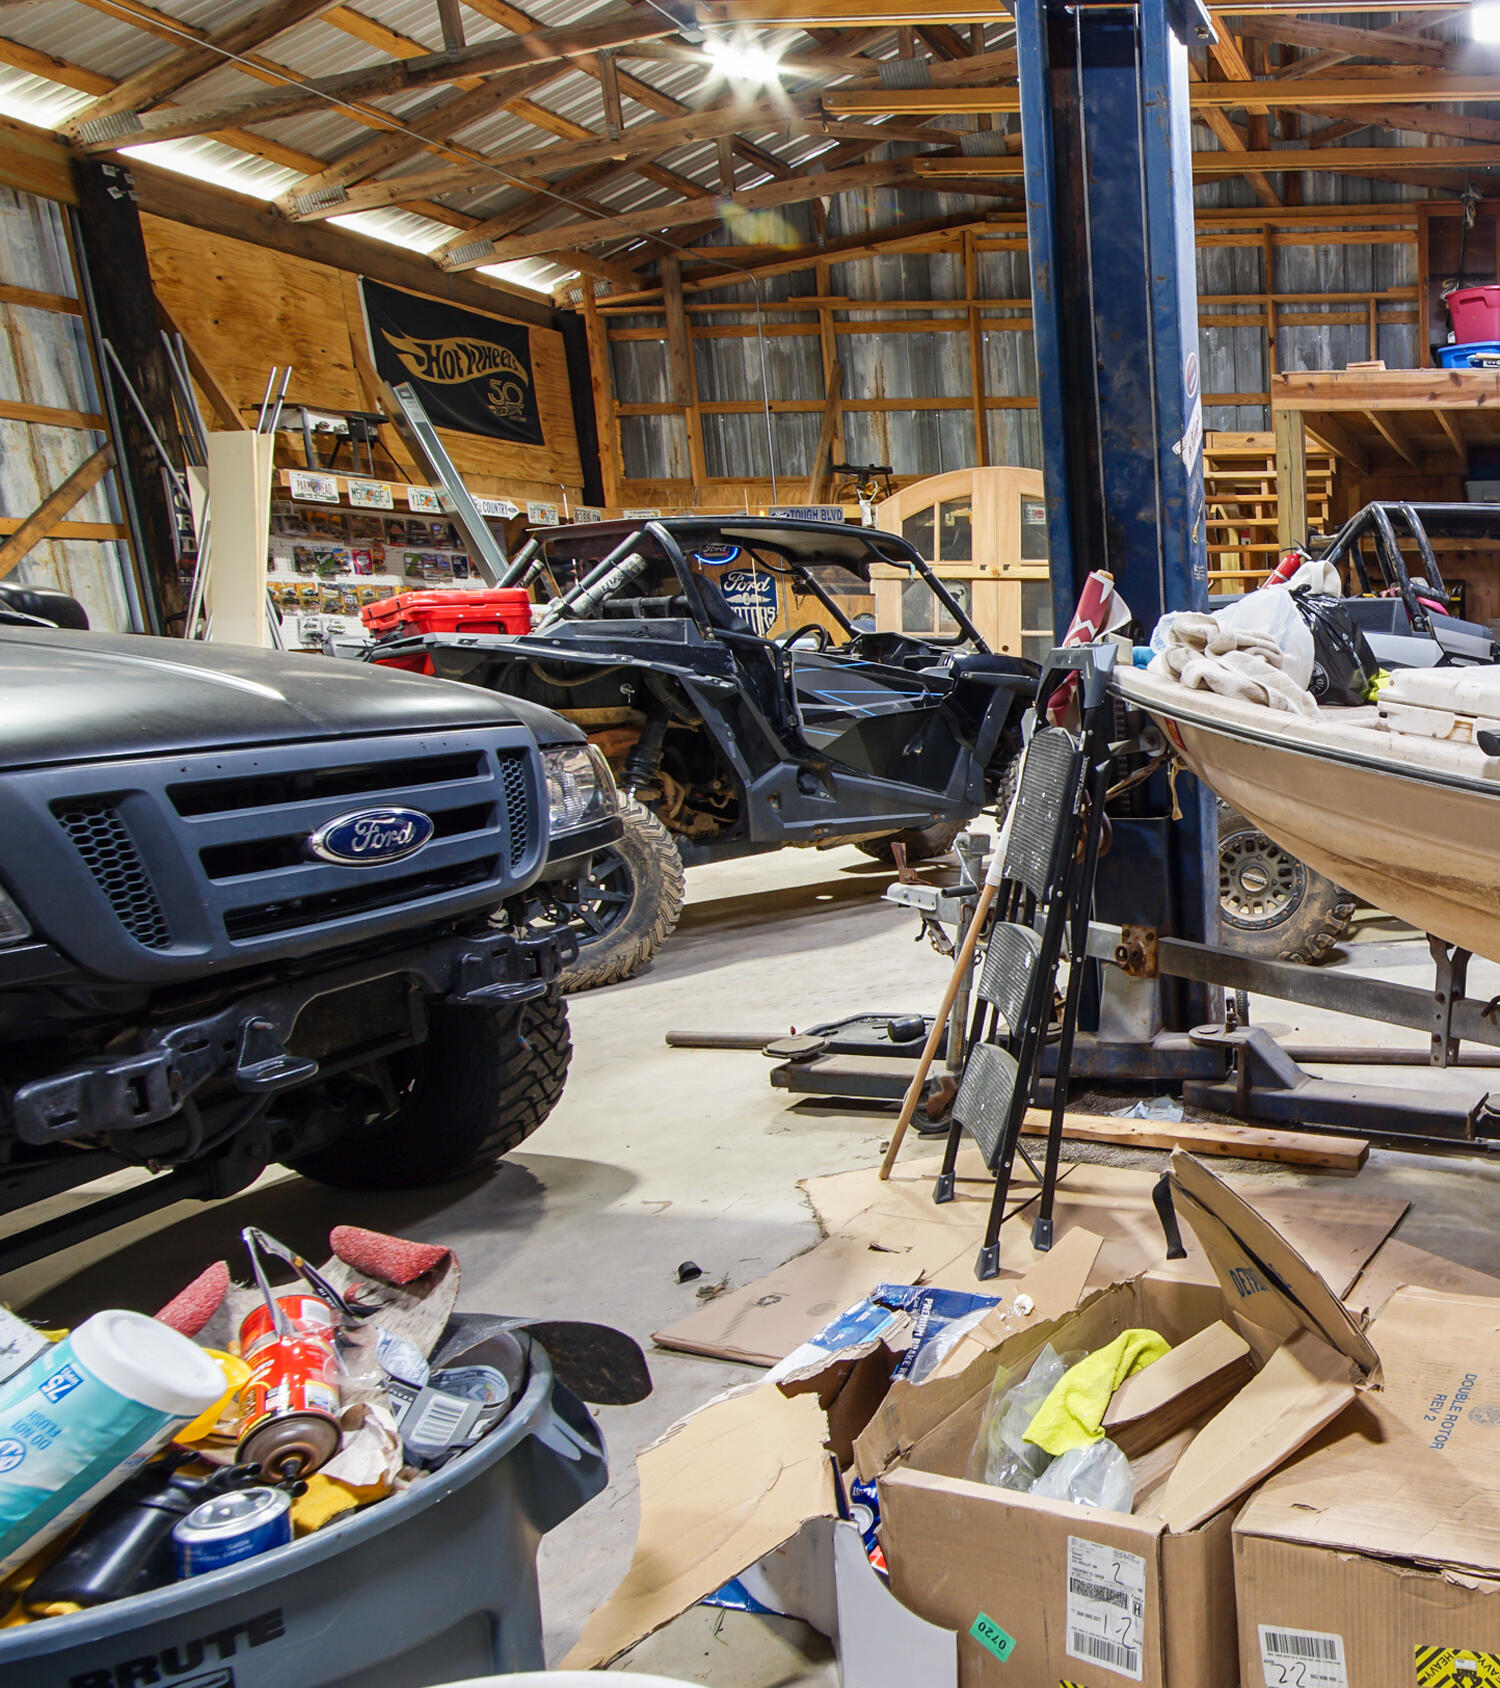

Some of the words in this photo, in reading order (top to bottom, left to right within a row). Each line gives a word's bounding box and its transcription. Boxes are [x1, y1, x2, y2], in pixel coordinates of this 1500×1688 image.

[487, 378, 524, 407] 50
[482, 501, 508, 515] COUNTRY
[790, 508, 818, 520] TOUGH
[820, 508, 843, 521] BLVD
[723, 570, 771, 593] Ford
[350, 815, 415, 855] Ford
[913, 1297, 934, 1338] PREMIUM
[901, 1338, 922, 1367] BRAKE
[1428, 1393, 1448, 1414] REV
[1448, 1373, 1478, 1413] DOUBLE
[25, 1409, 63, 1438] FLUSH
[1423, 1414, 1437, 1422] 2
[1429, 1413, 1459, 1450] ROTOR
[70, 1608, 286, 1688] BRUTE
[977, 1620, 1008, 1651] 0720
[1425, 1651, 1454, 1679] HEAVY
